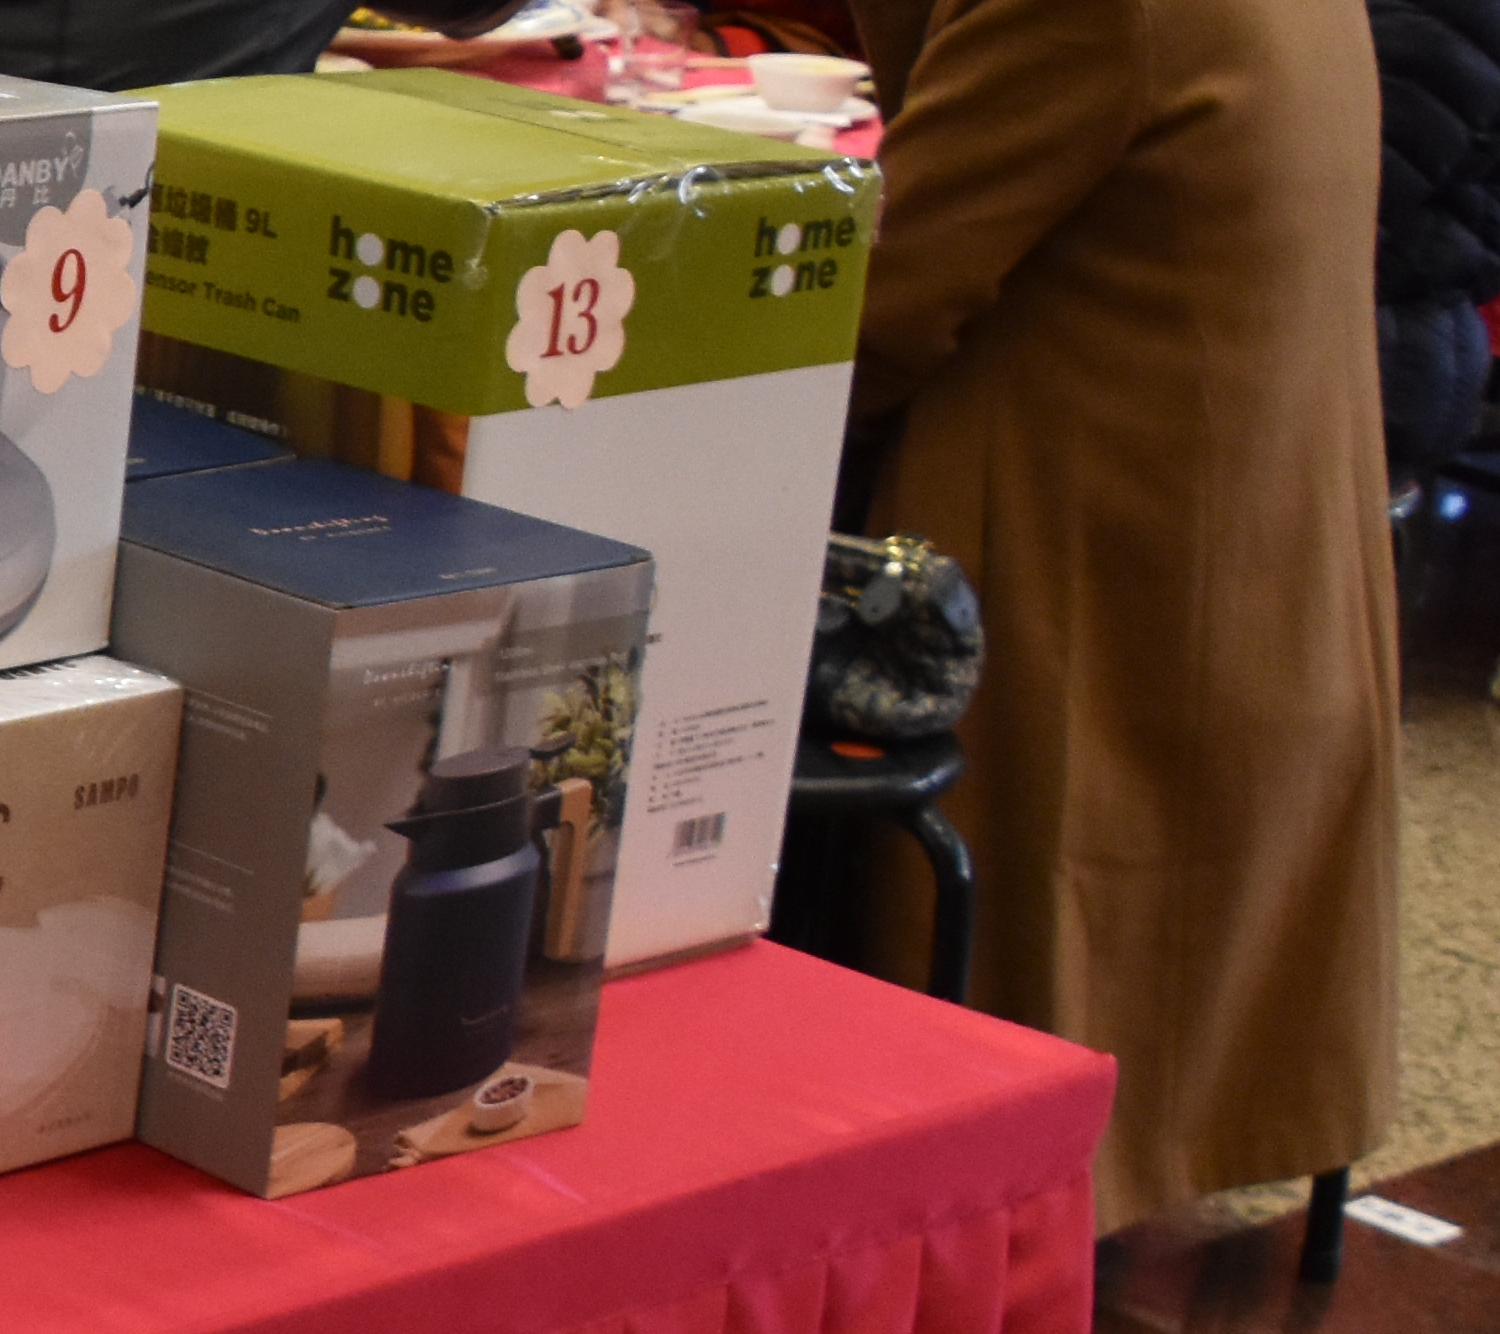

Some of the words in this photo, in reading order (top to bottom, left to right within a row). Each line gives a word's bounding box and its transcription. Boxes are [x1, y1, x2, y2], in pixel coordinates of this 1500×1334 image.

[329, 215, 454, 284] home
[49, 249, 86, 333] 9
[204, 282, 256, 312] Trash
[262, 297, 300, 323] Can
[327, 268, 435, 323] zone
[539, 277, 600, 359] 13
[74, 773, 140, 809] SAMPO
